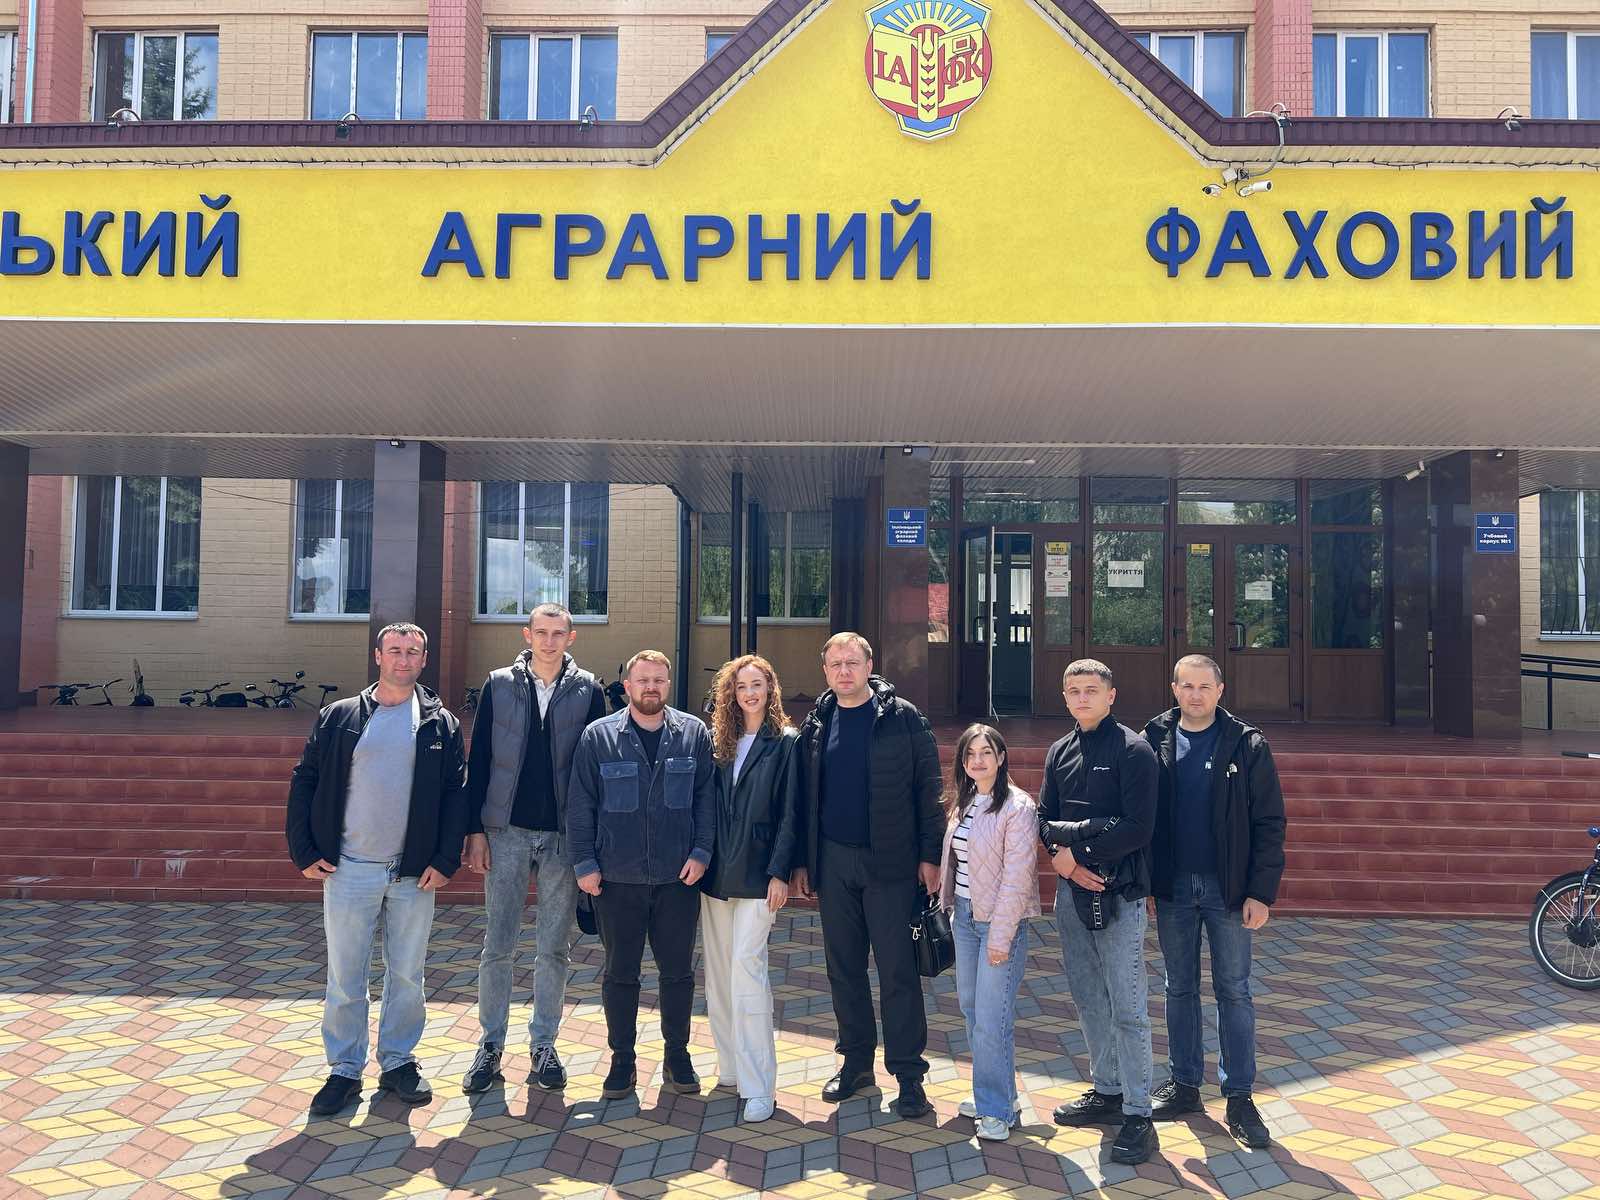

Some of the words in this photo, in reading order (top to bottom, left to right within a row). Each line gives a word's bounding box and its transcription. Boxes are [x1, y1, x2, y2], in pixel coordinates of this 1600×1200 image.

[0, 194, 240, 277] ЬКИЙ
[421, 199, 932, 282] АГРАРНИЙ
[1145, 196, 1574, 281] ФАХОВИЙ
[1108, 568, 1143, 576] УКРИТТЯ
